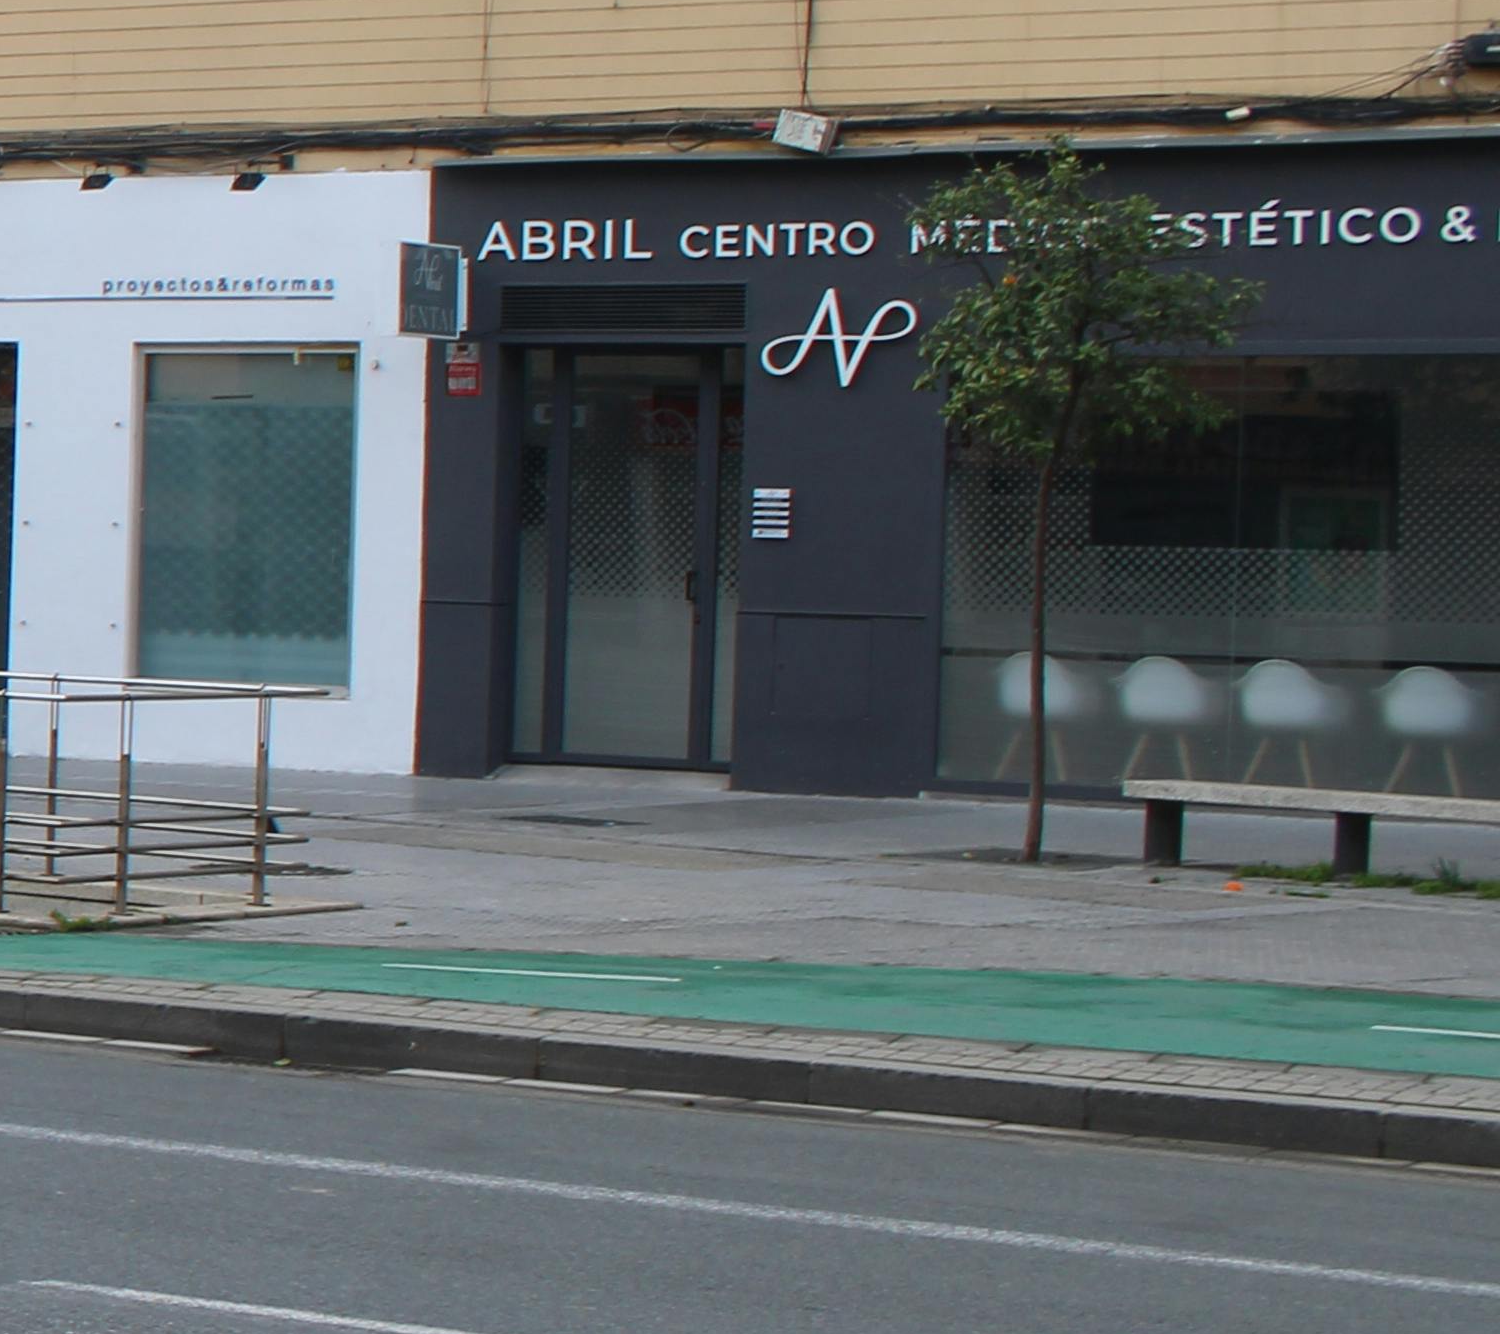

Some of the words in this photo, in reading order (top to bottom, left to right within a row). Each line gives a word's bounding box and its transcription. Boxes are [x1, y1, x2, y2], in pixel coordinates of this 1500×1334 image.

[477, 218, 654, 261] ABRIL
[678, 220, 877, 259] CENTRO
[1440, 204, 1477, 243] &
[102, 277, 335, 296] proyectos&reformas
